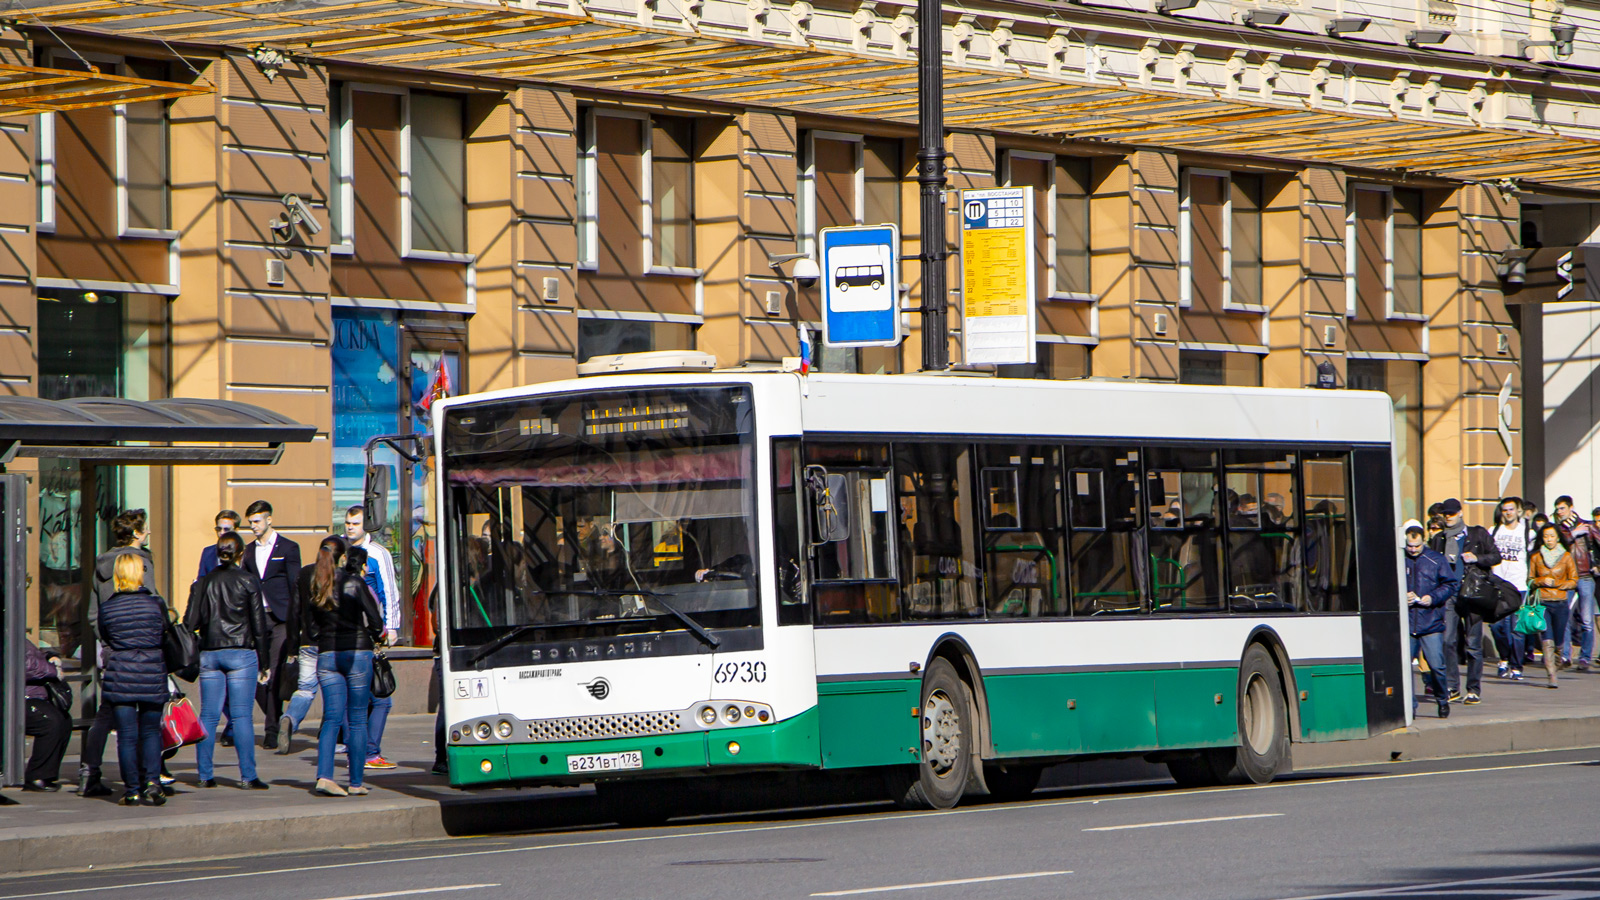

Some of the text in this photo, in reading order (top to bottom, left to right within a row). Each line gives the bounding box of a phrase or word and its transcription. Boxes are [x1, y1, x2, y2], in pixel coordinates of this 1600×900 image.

[1010, 199, 1019, 207] 10
[1010, 218, 1019, 226] 22
[1498, 547, 1522, 555] ARTY
[714, 661, 767, 684] 6930
[620, 752, 638, 764] 178
